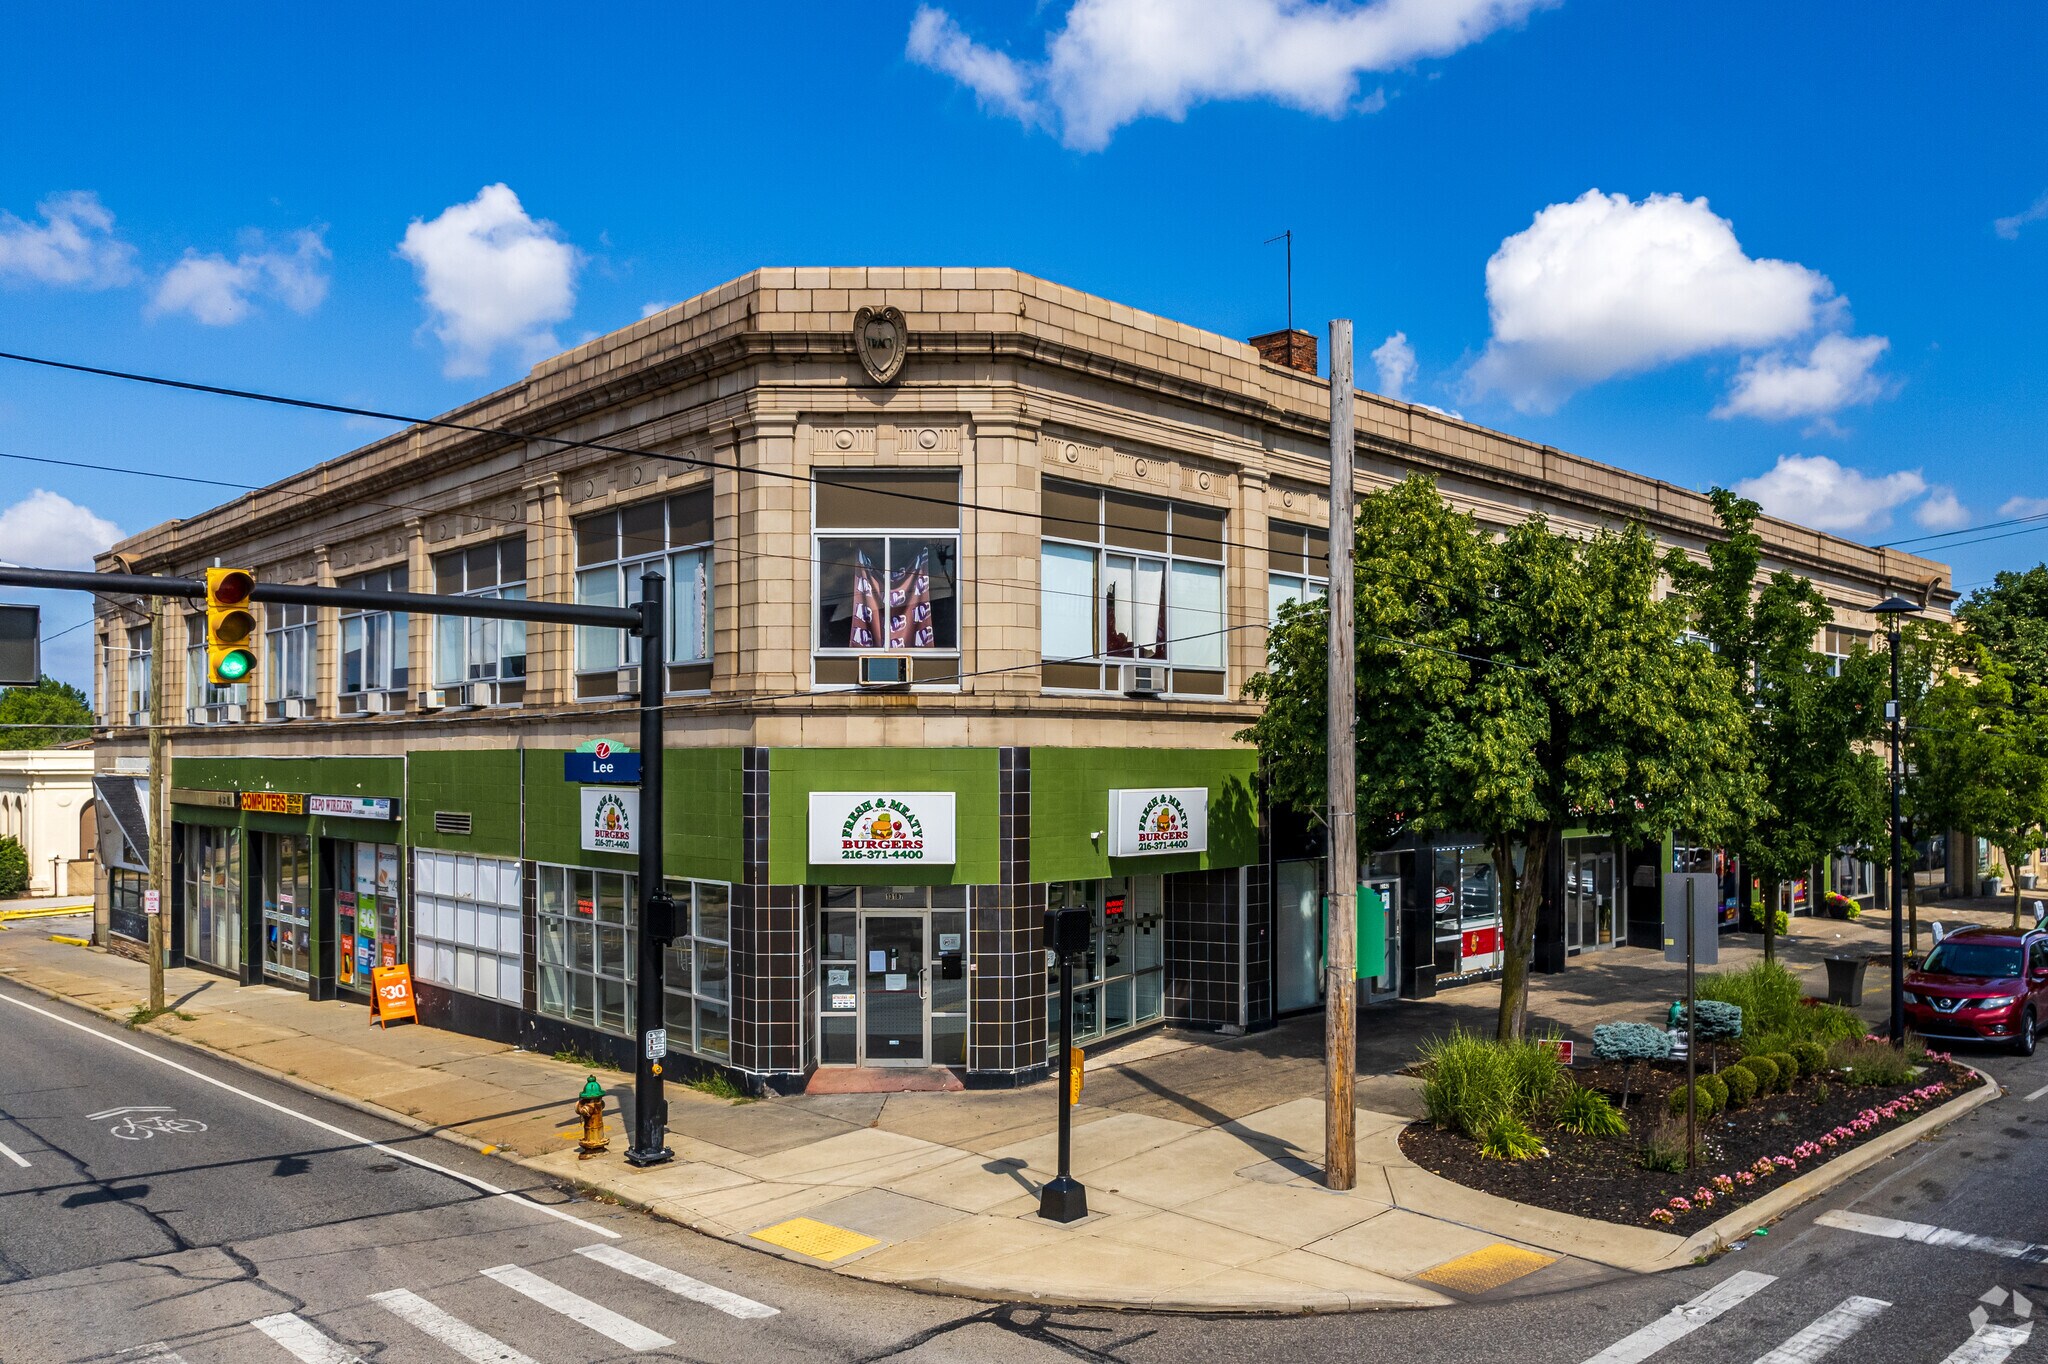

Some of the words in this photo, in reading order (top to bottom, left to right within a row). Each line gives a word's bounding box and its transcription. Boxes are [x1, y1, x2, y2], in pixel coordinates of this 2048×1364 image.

[593, 761, 614, 773] Lee
[242, 793, 286, 812] COMPUTERS
[312, 798, 324, 811] EXPO
[325, 799, 353, 814] WIRELESS
[594, 795, 608, 828] FRESH
[608, 793, 613, 803] &
[613, 794, 630, 830] MEATY
[841, 799, 874, 839] FRESH
[875, 798, 887, 809] &
[888, 799, 924, 839] MEATY
[1138, 796, 1159, 831] FRESH
[1159, 794, 1167, 804] &
[1168, 794, 1189, 829] MEATY
[594, 829, 630, 840] BURGERS
[1138, 831, 1189, 842] BURGERS
[594, 838, 630, 849] 216-371-4400
[841, 840, 924, 849] BURGERS
[1138, 840, 1189, 851] 216-371-4400
[841, 850, 924, 859] 216-371-4400
[360, 909, 375, 929] 5G
[380, 984, 406, 1000] $30
